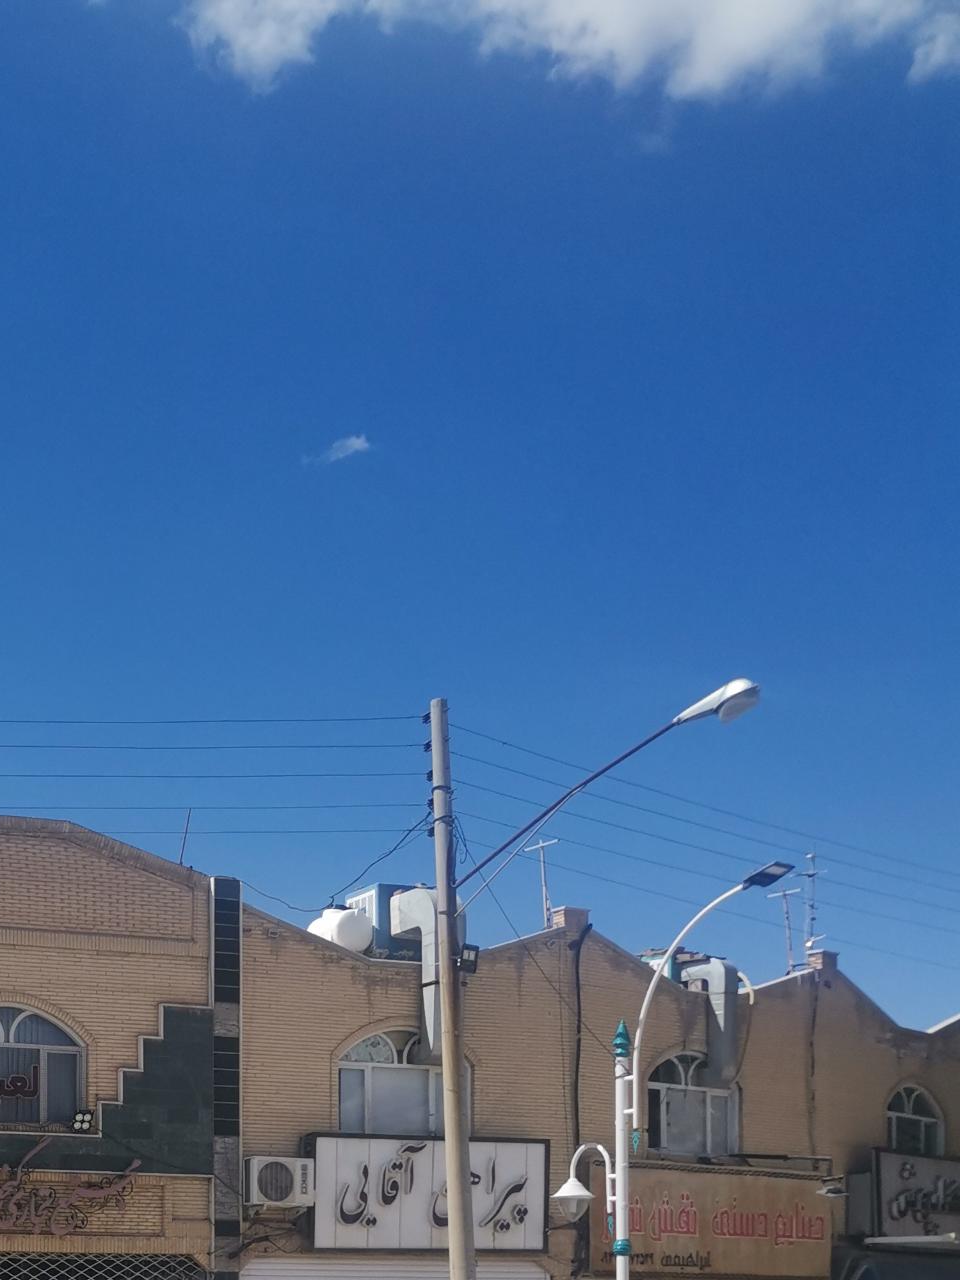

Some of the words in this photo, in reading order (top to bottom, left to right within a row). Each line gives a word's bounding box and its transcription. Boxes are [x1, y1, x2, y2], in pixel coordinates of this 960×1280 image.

[338, 1142, 429, 1228] آقایی
[649, 1190, 699, 1243] نقش
[712, 1197, 770, 1238] دستی
[773, 1202, 826, 1246] صنایع
